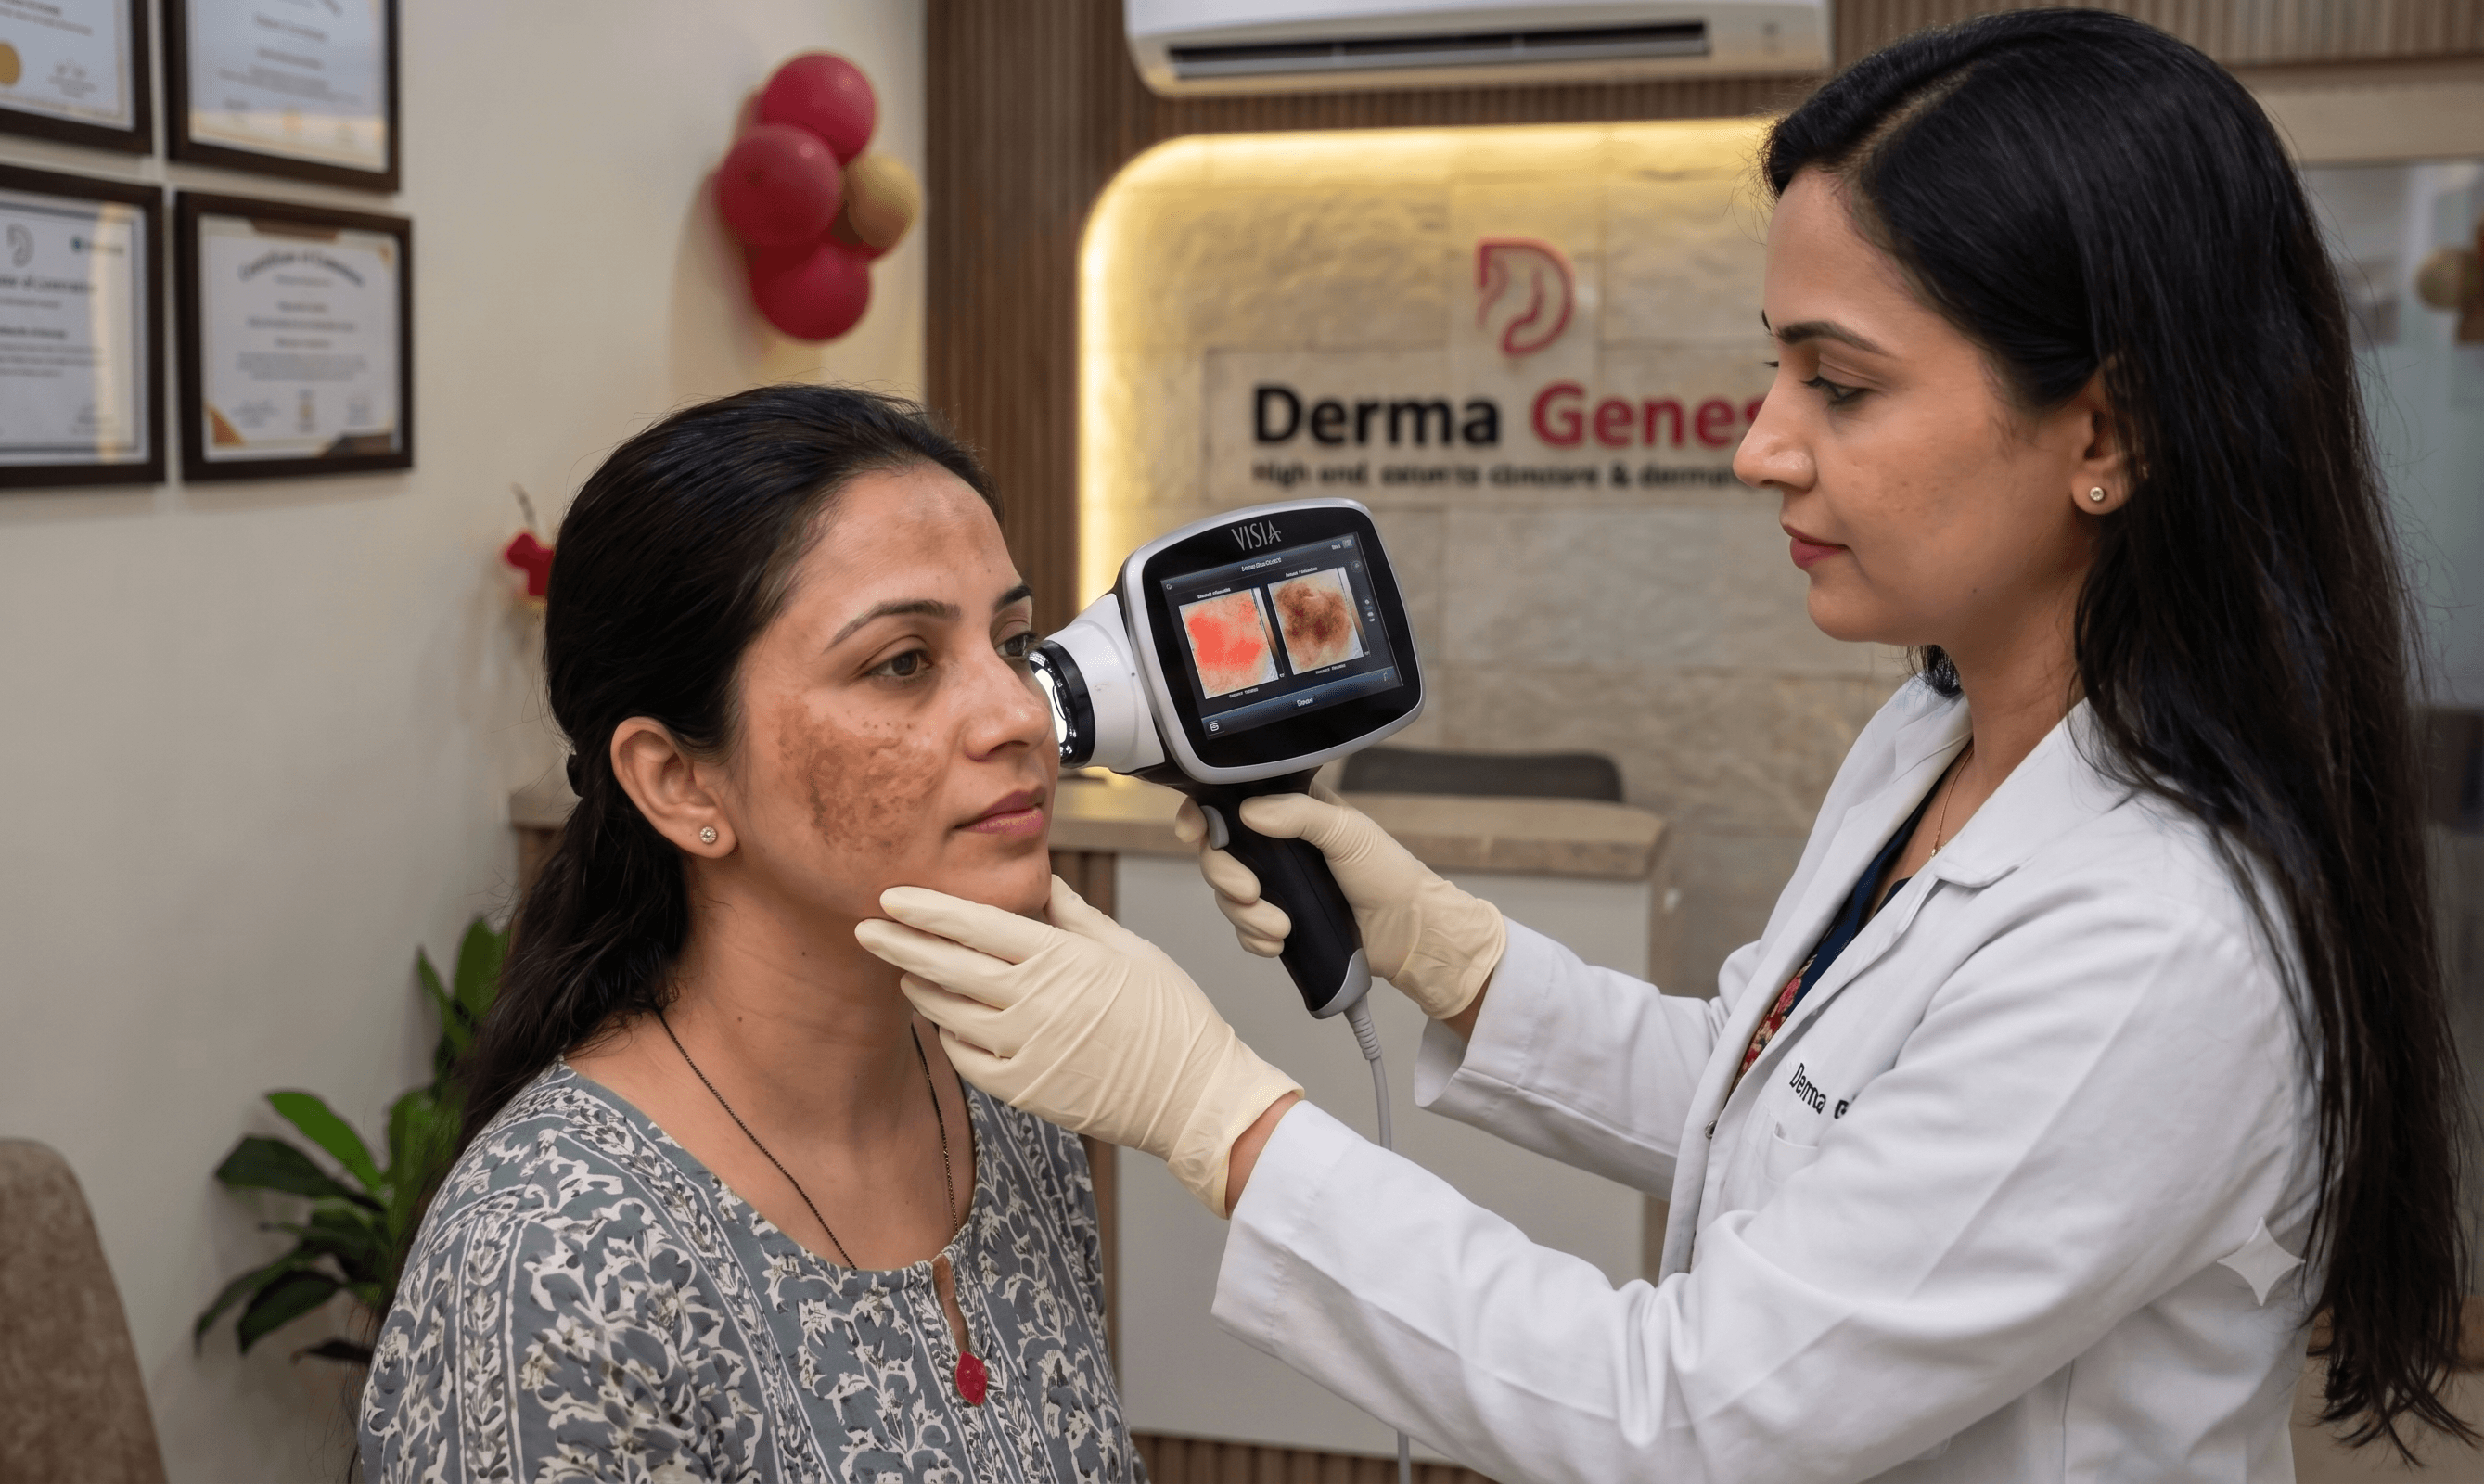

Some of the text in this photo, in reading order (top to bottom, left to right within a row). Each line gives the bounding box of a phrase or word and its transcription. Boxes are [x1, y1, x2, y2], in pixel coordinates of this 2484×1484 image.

[1253, 383, 1501, 447] Derma
[1231, 520, 1281, 551] VISIA
[1789, 1062, 1826, 1114] Derma
